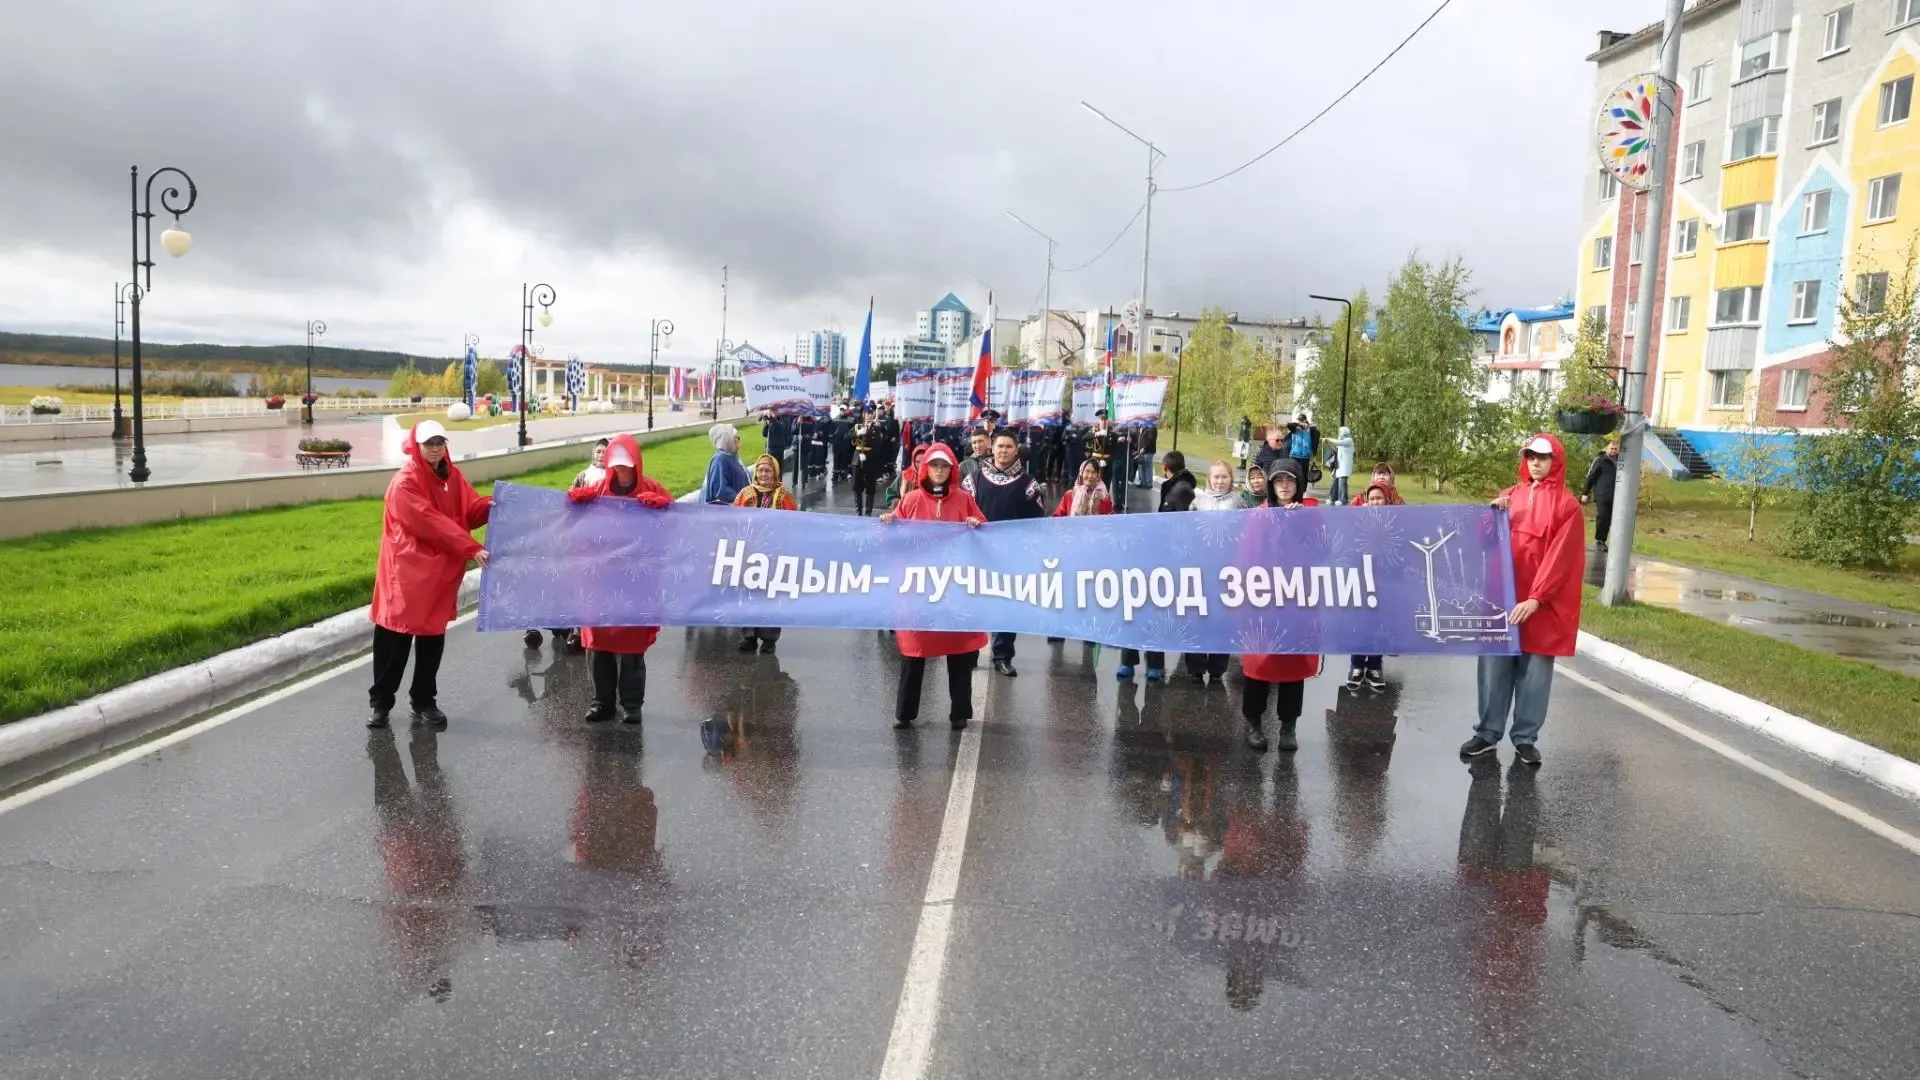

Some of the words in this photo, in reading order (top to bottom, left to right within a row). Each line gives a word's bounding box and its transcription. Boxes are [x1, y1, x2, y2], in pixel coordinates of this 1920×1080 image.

[712, 539, 890, 598] Надым-
[898, 558, 1063, 610] лучший
[1076, 566, 1208, 621] город
[1219, 554, 1378, 608] земли!
